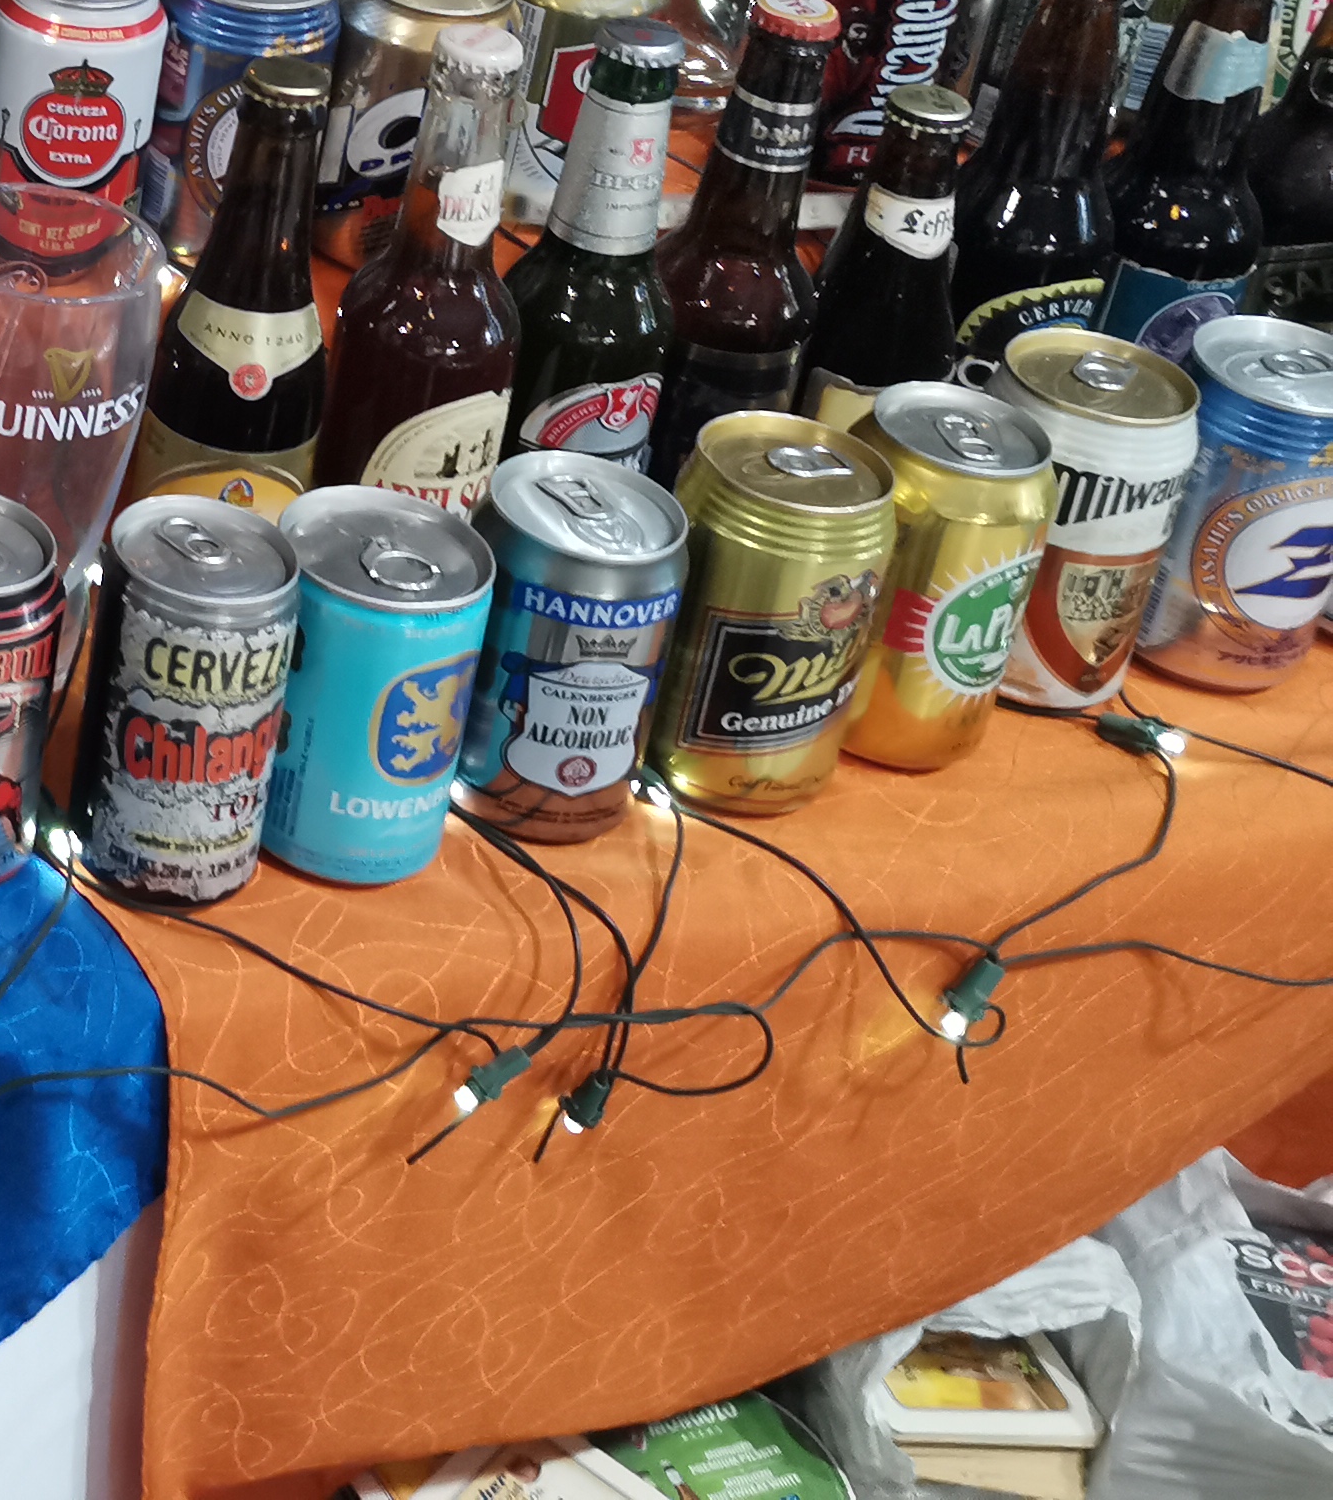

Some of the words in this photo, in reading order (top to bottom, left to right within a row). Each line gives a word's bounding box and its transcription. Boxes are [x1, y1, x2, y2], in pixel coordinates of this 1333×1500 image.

[46, 101, 109, 117] CERVEZA
[29, 115, 119, 143] Corona
[48, 151, 93, 165] EXTRA
[203, 322, 255, 345] ANNO
[547, 402, 602, 444] BRAUEREI
[524, 587, 680, 628] HANNOVER
[565, 703, 610, 727] NON
[720, 699, 834, 734] Genuine
[526, 722, 634, 750] ALCOHOLIC
